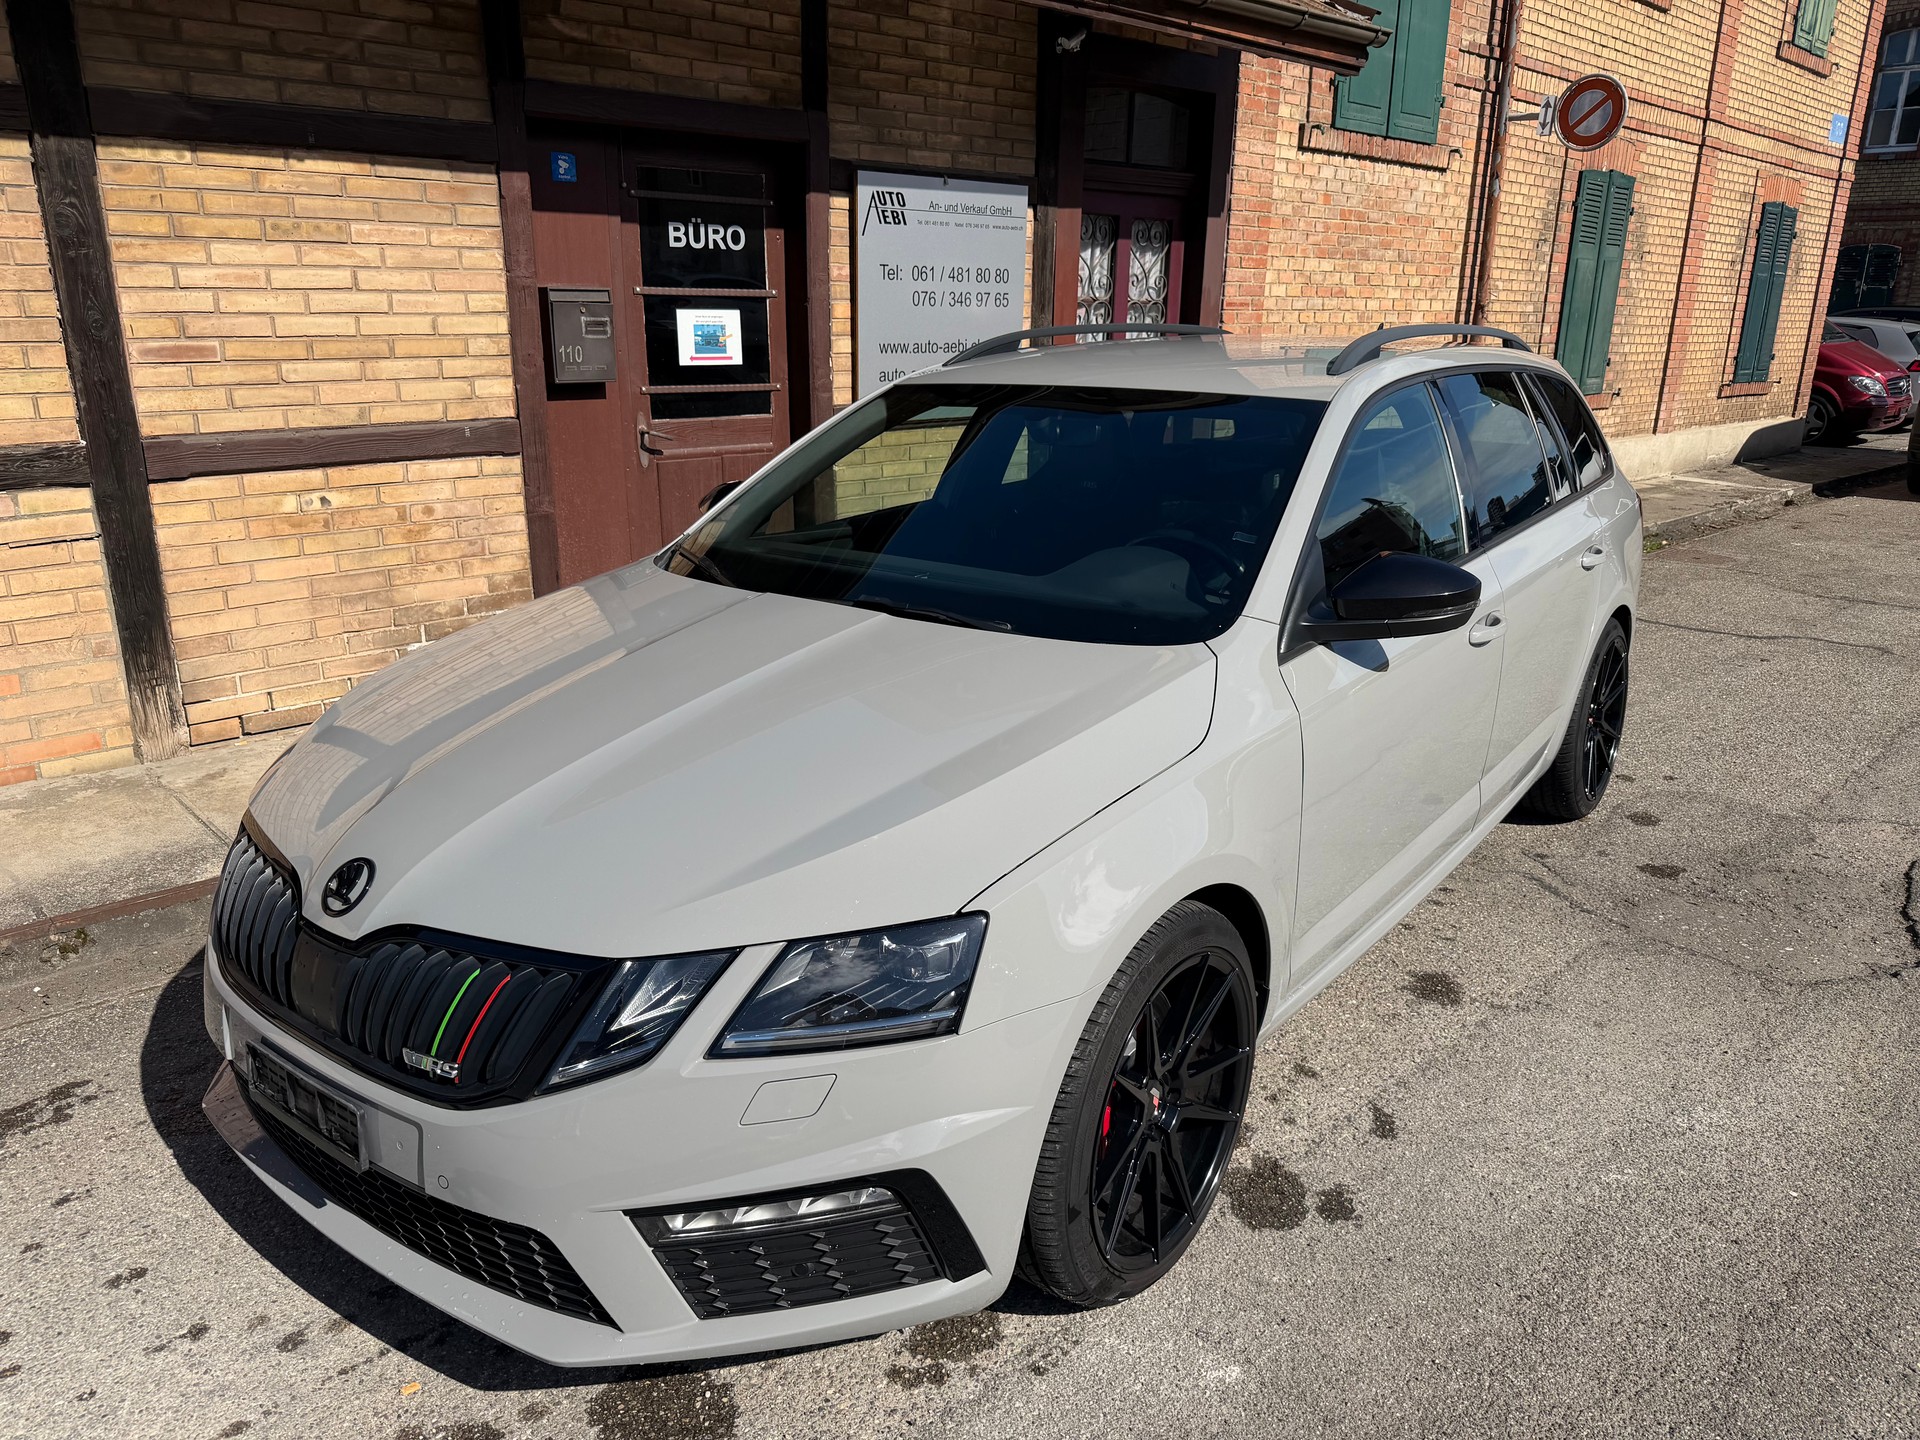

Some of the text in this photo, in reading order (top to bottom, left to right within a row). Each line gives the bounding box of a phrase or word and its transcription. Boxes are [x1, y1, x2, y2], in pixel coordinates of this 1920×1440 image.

[868, 190, 906, 208] AUTO
[929, 200, 1012, 216] An- und Verkauf GmbH
[668, 217, 746, 251] BÜRO
[879, 263, 1010, 284] Tel: 061 / 481 80 80
[912, 290, 1010, 308] 076 / 346 97 65
[559, 345, 583, 363] 110
